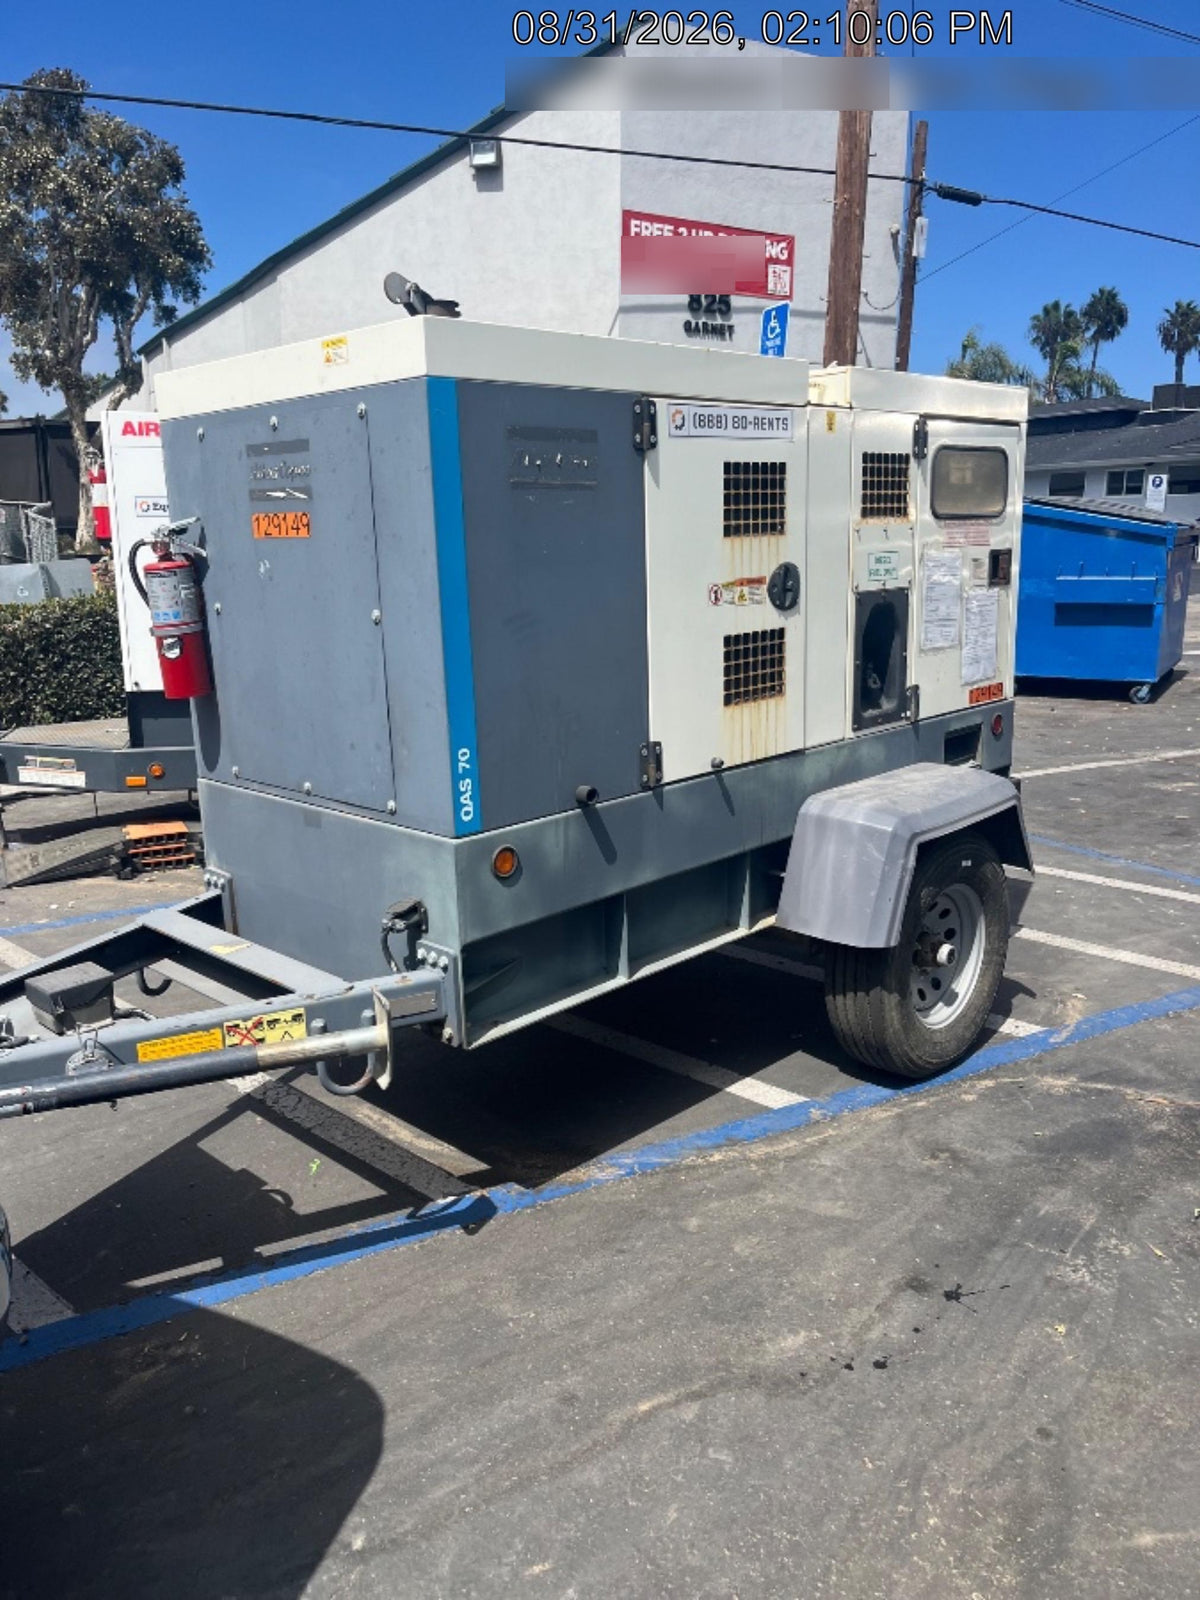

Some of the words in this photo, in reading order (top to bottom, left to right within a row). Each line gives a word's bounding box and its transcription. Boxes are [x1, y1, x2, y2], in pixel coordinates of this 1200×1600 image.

[688, 294, 732, 315] 825
[683, 320, 735, 339] GARNET
[693, 412, 728, 431] (888)
[732, 415, 789, 432] 80-RENTS
[253, 512, 311, 536] 129149
[458, 747, 471, 774] 70
[460, 778, 474, 822] QAS
